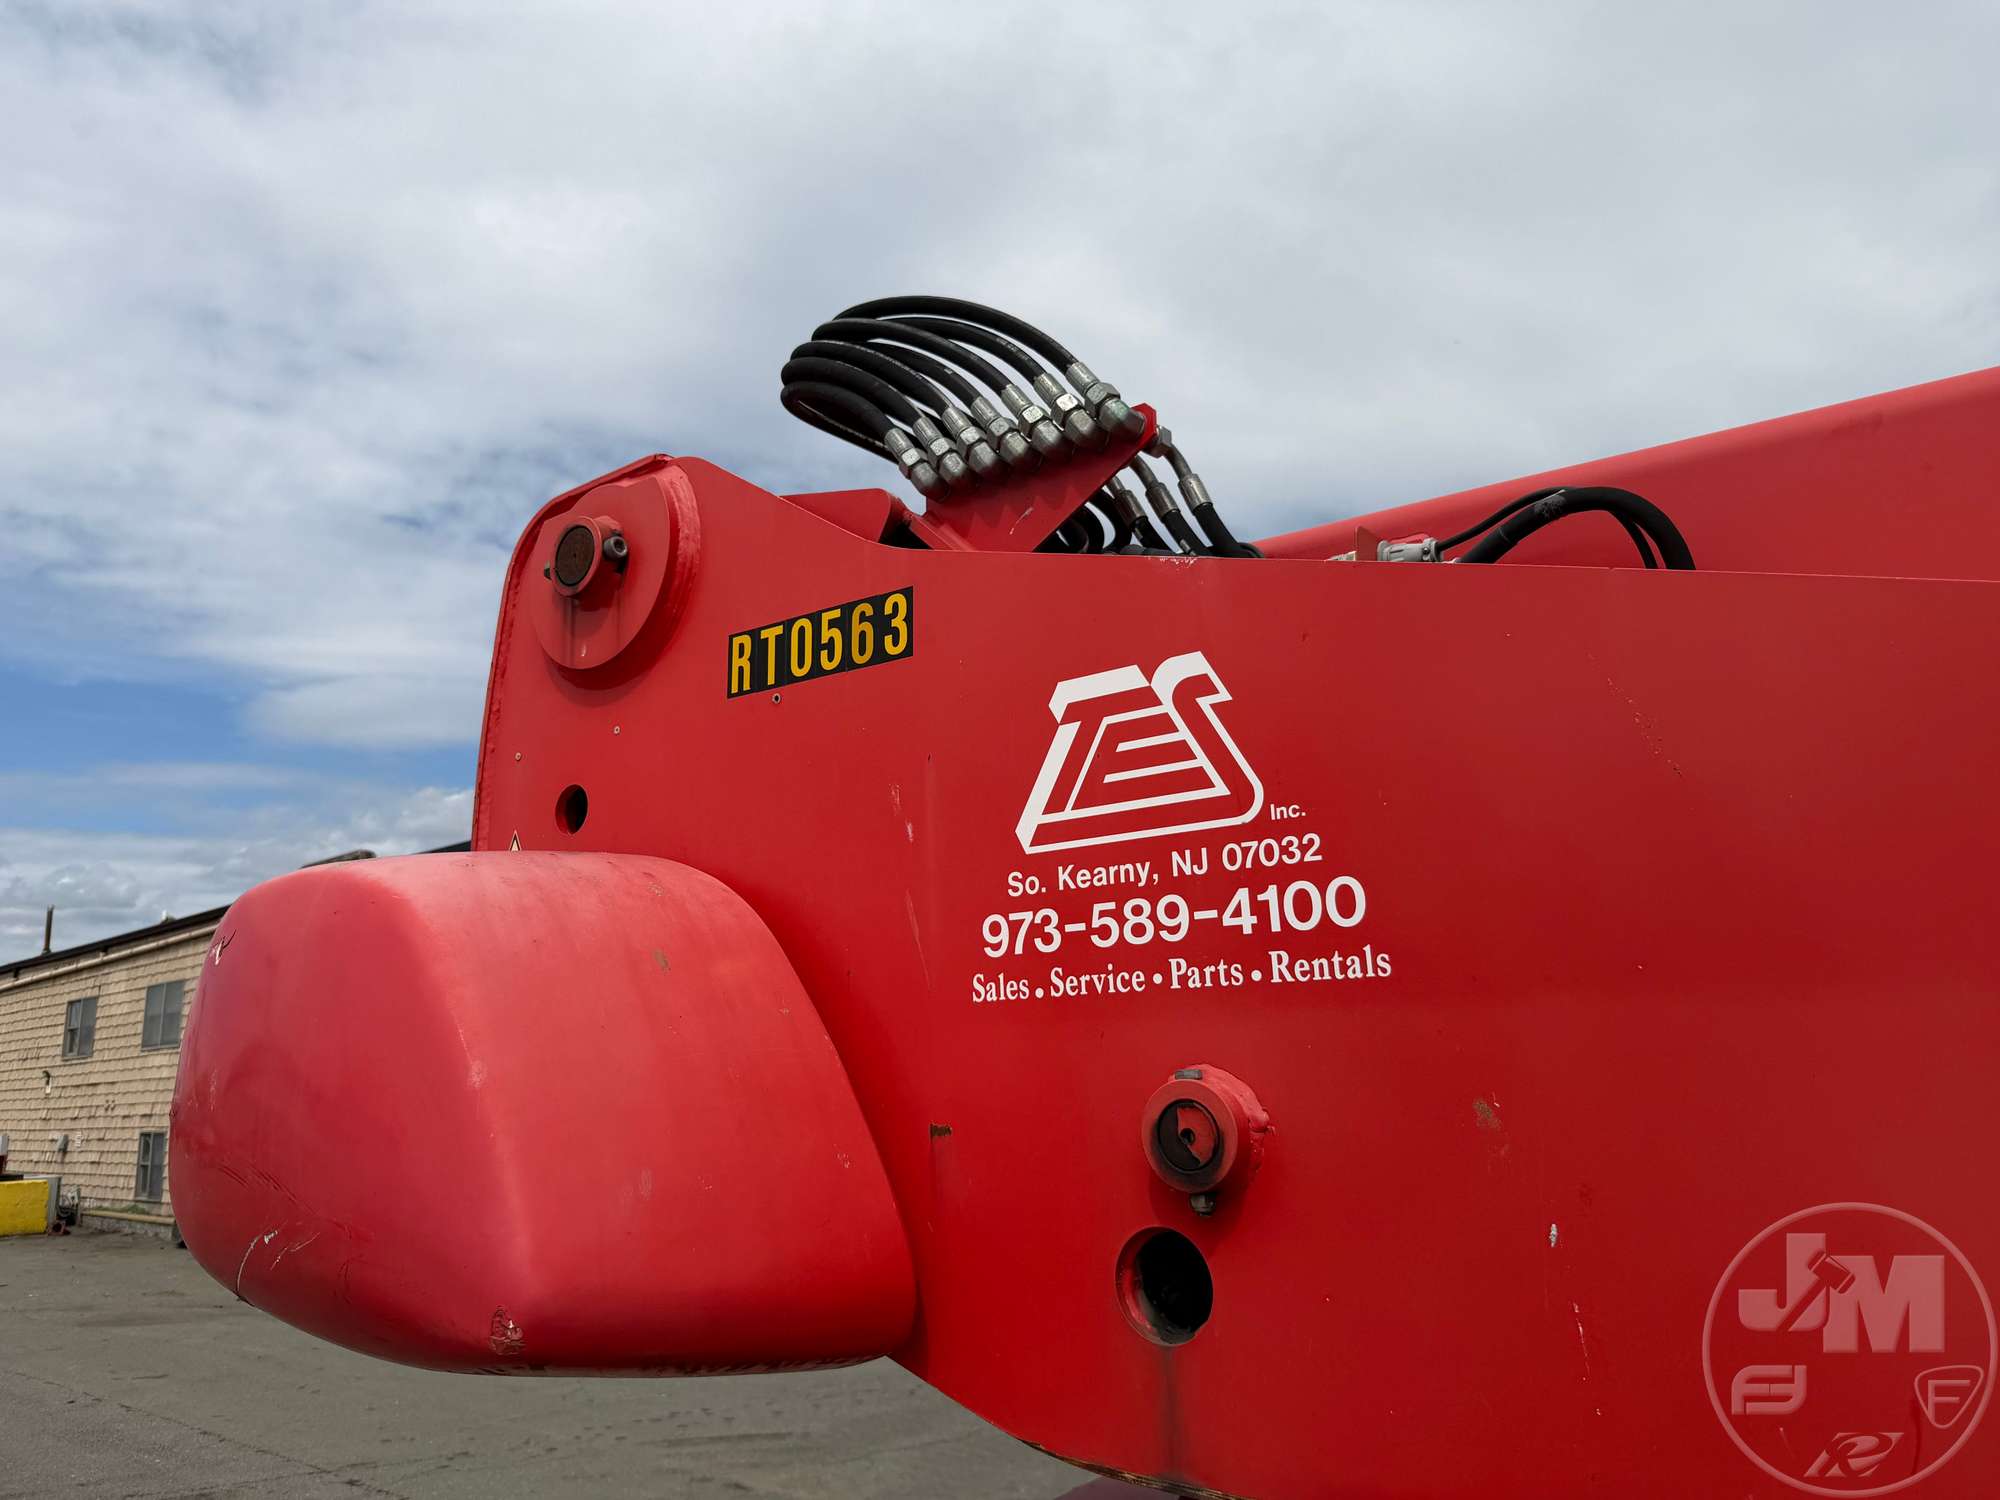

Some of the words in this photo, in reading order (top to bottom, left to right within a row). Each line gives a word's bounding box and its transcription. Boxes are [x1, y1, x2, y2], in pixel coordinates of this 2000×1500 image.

[730, 592, 908, 696] RT0563
[1270, 802, 1306, 821] Inc.
[1007, 871, 1047, 897] So.
[1057, 860, 1159, 891] Kearny,
[1171, 847, 1209, 877] NJ
[1221, 832, 1323, 871] 07032
[982, 875, 1366, 958] 973-589-4100
[972, 973, 1030, 1003] Sales
[1050, 963, 1146, 998] Service
[1168, 957, 1244, 989] Parts
[1268, 943, 1392, 983] Rentals
